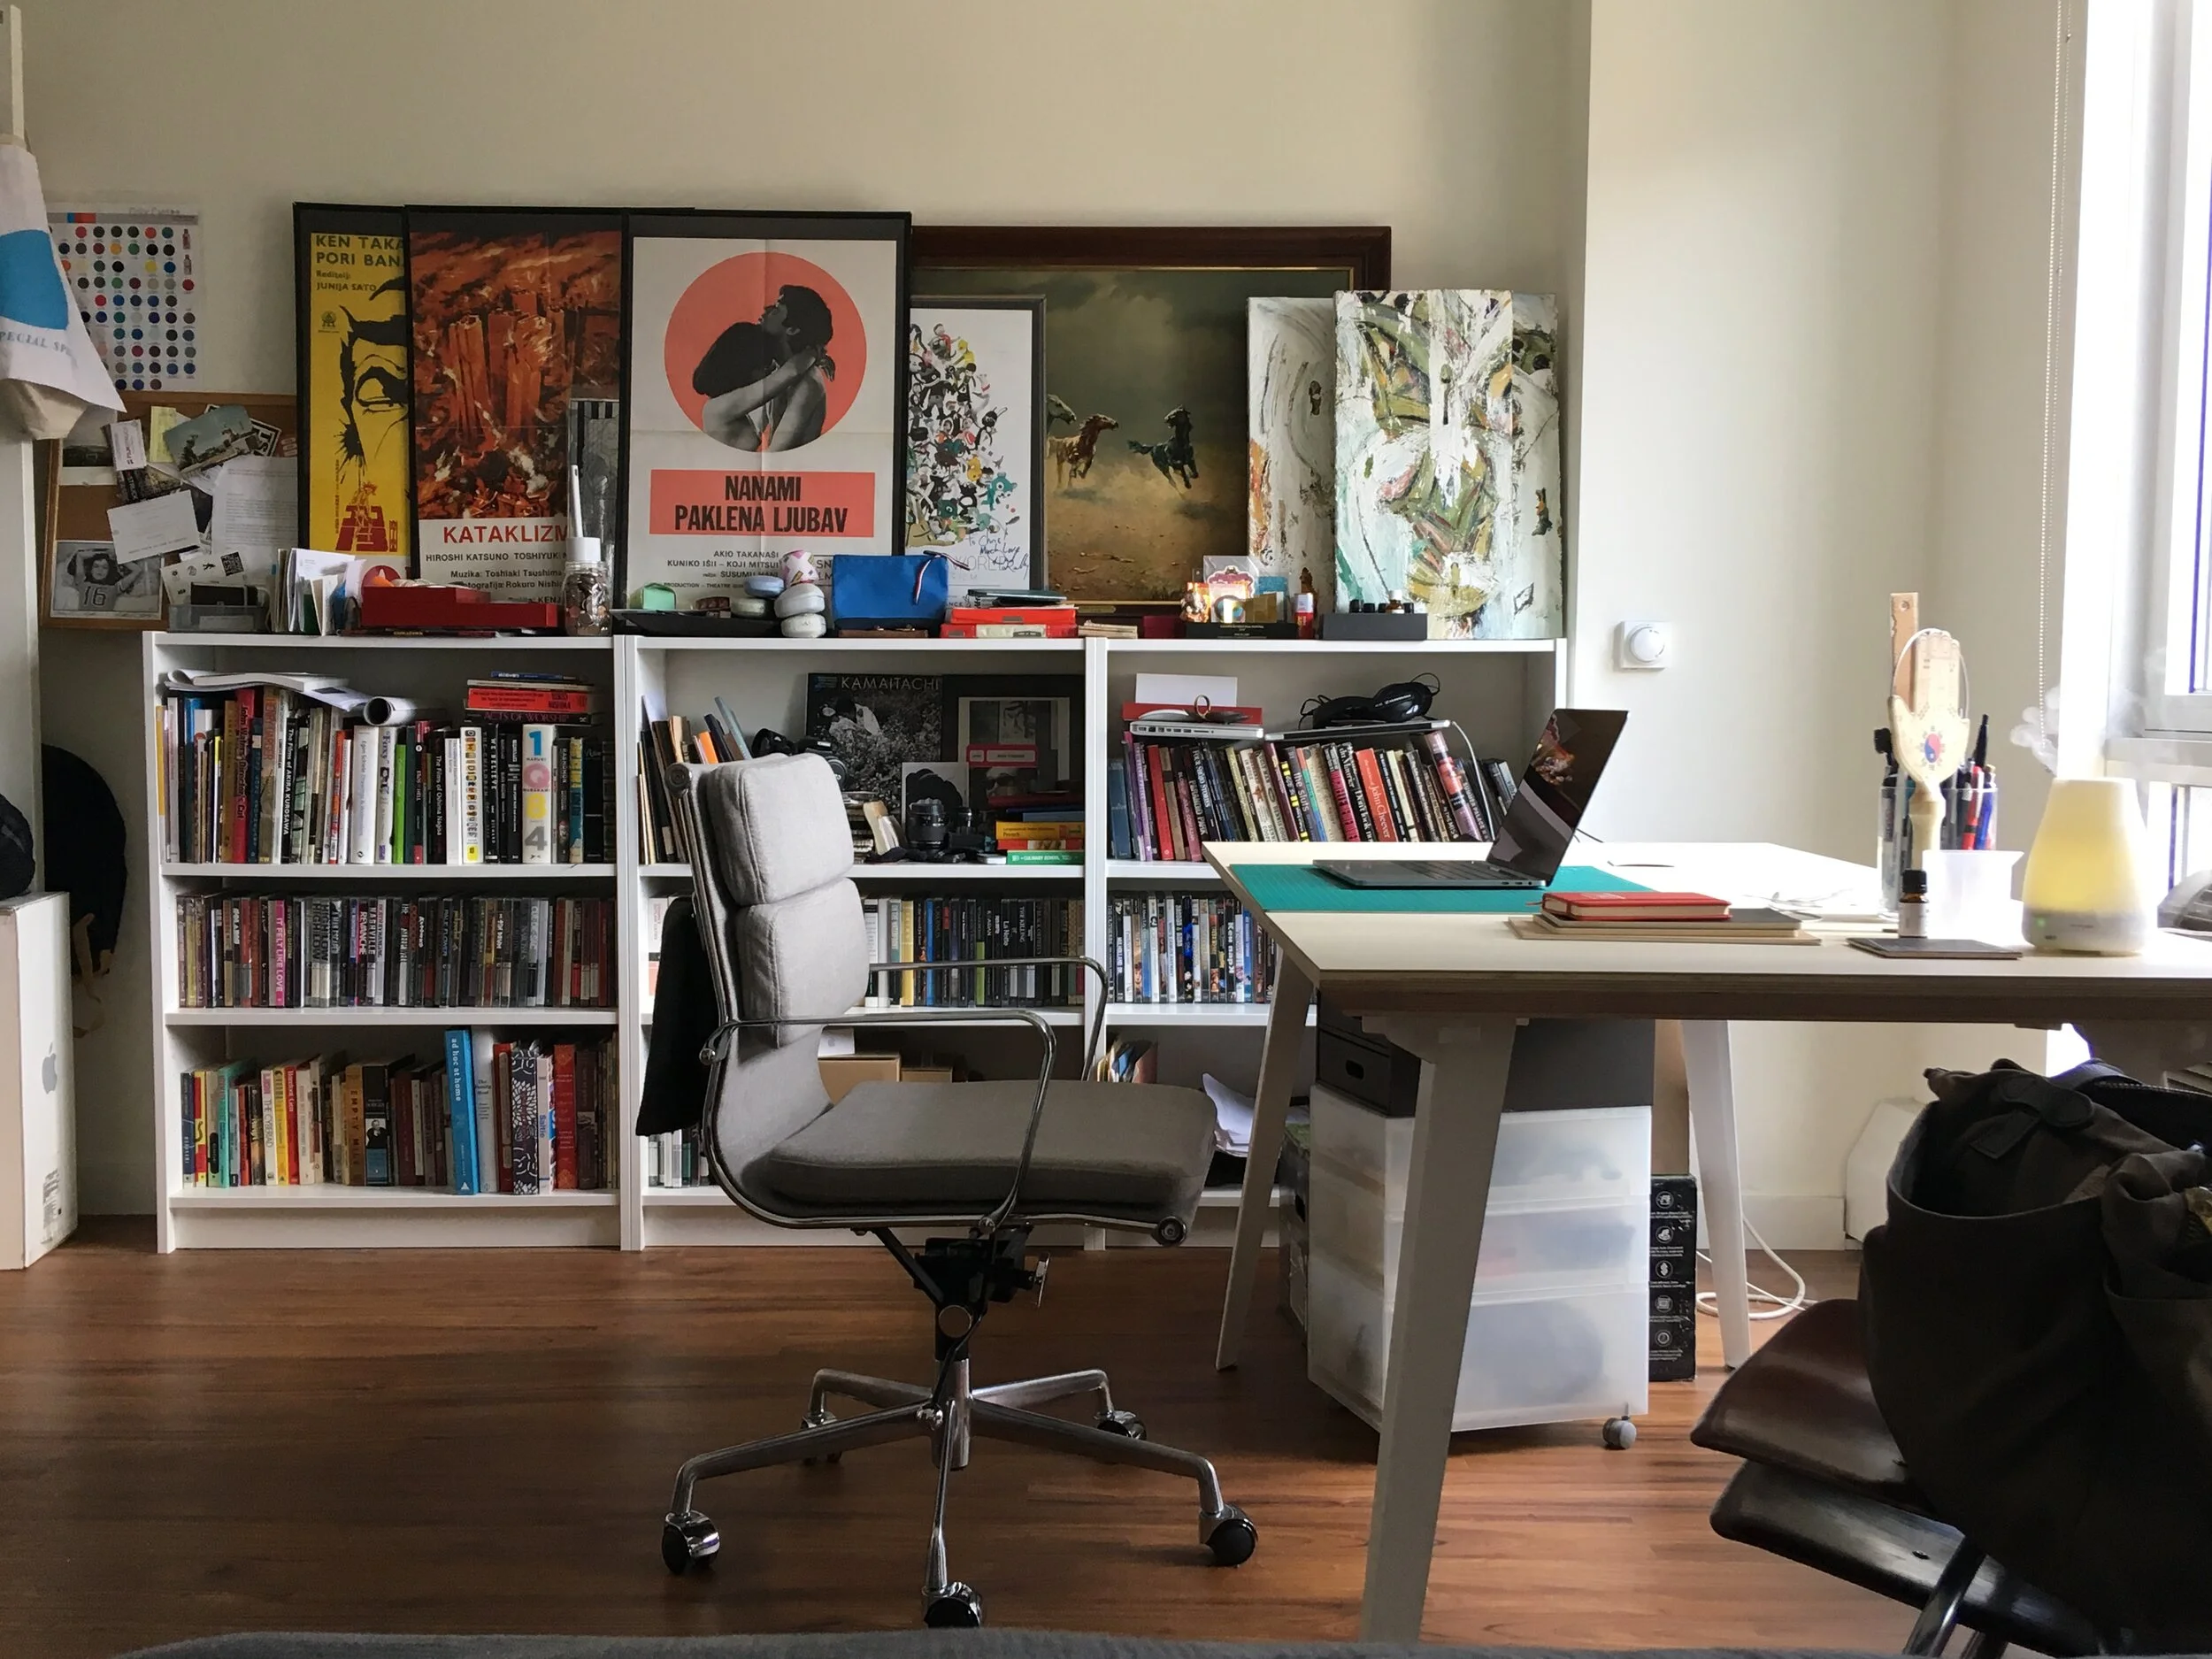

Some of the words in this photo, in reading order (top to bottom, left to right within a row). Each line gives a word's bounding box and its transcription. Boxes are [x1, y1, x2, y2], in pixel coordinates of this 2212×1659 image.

[316, 234, 350, 248] KEN
[317, 252, 356, 265] PORI
[365, 254, 404, 267] BAN
[317, 282, 349, 292] JUNIJA
[725, 475, 803, 502] NANAMI
[674, 504, 765, 533] PAKLENA
[772, 506, 849, 534] LJUBAV
[450, 570, 482, 579] Muzika:
[485, 569, 521, 578] Toshiaki
[667, 558, 705, 570] KUNIKO
[727, 561, 747, 571] KOJI
[749, 562, 780, 572] MITSUI
[505, 580, 535, 590] Rokuro
[841, 676, 940, 690] KAMAITACHI
[239, 708, 249, 725] John
[489, 737, 497, 750] WE
[1192, 749, 1202, 765] FOUR
[1198, 784, 1211, 808] STORIES
[1292, 772, 1304, 788] the
[1341, 757, 1356, 788] Maurier
[436, 784, 443, 793] of
[1368, 785, 1381, 806] John
[1187, 779, 1202, 816] PARANOID
[1195, 816, 1209, 836] PARK
[1296, 789, 1311, 813] sluts
[1462, 781, 1476, 807] SUMMER
[1469, 806, 1486, 830] PALACE
[1271, 805, 1282, 826] DENNIS
[1362, 812, 1374, 831] look
[1373, 805, 1392, 839] Cheever
[276, 917, 284, 926] IT
[311, 903, 320, 931] HIGH
[320, 905, 329, 933] HIGH
[1002, 920, 1010, 929] La
[275, 926, 284, 949] FELT
[358, 910, 368, 956] REVANCHE
[367, 906, 377, 956] NASHVILLE
[311, 934, 320, 961] LOW
[320, 936, 329, 963] LOW
[275, 949, 284, 970] LIKE
[275, 970, 284, 992] LOVE
[451, 1038, 459, 1048] ad
[451, 1050, 461, 1066] hoc
[452, 1067, 461, 1077] at
[287, 1070, 297, 1097] Barefoot
[453, 1077, 463, 1102] home
[264, 1100, 273, 1113] THE
[349, 1089, 359, 1131] EMPTY
[265, 1113, 274, 1148] CYBERIAD
[538, 1114, 547, 1139] Saltie
